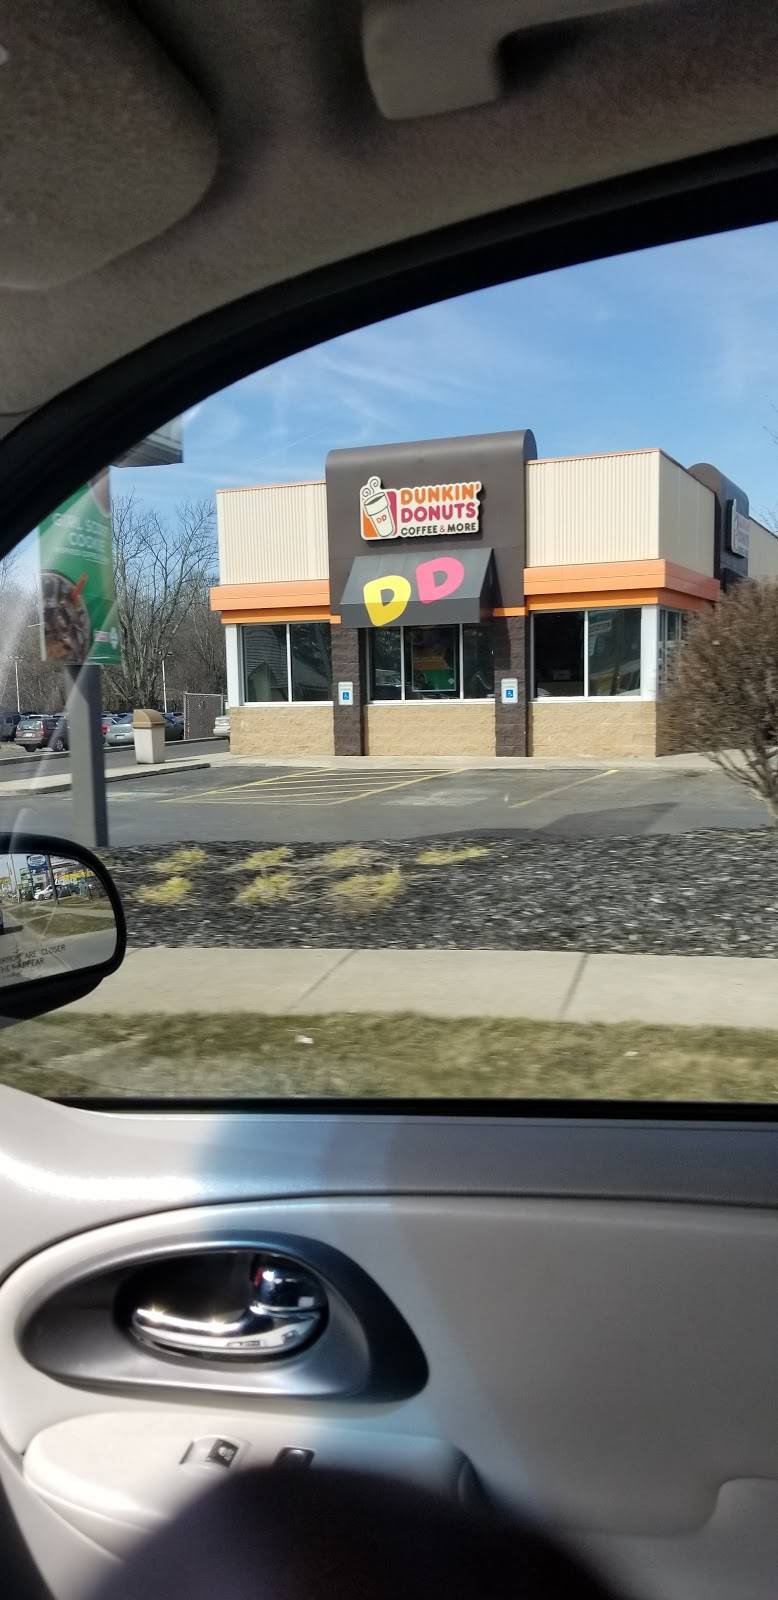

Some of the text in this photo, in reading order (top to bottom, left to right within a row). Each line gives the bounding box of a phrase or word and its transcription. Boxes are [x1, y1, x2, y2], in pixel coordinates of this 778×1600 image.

[400, 483, 480, 505] DUNKIN'
[400, 502, 476, 523] DONUTS
[400, 522, 476, 536] COFFEE & MORE
[40, 944, 65, 955] CLOSER
